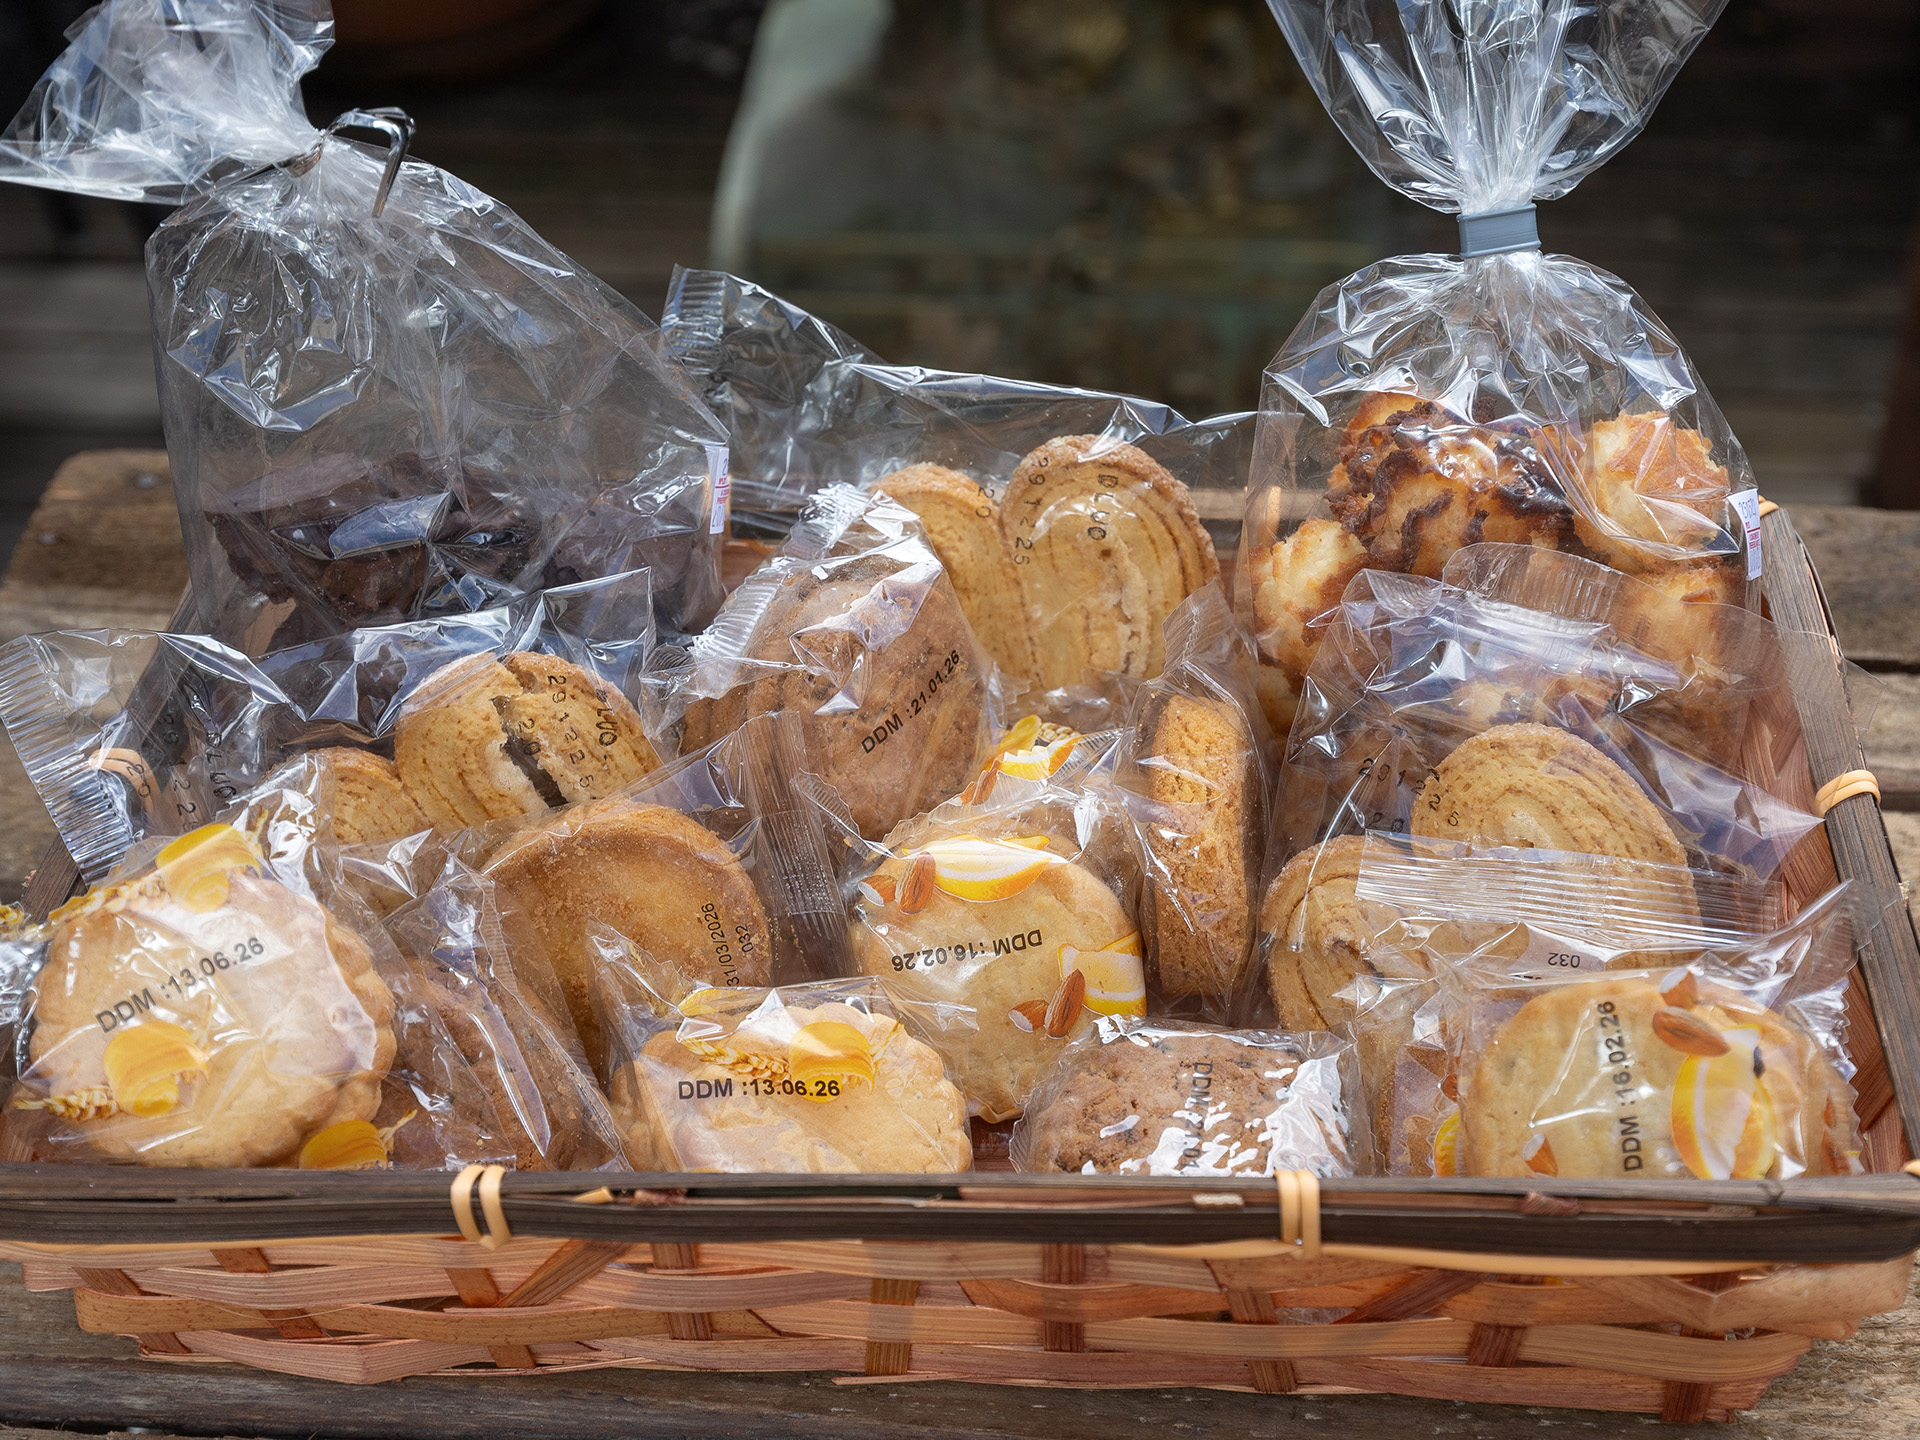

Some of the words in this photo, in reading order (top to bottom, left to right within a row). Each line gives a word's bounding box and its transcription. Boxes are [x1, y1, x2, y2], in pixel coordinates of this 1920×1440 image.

[861, 713, 904, 754] DDM
[701, 902, 740, 987] 31/03/2026
[735, 923, 754, 953] 032
[992, 929, 1043, 957] DDM
[1547, 952, 1581, 969] 032
[95, 987, 158, 1033] DDM
[678, 1078, 733, 1100] DDM
[1189, 1062, 1213, 1106] DDM
[1619, 1115, 1644, 1172] DDM
